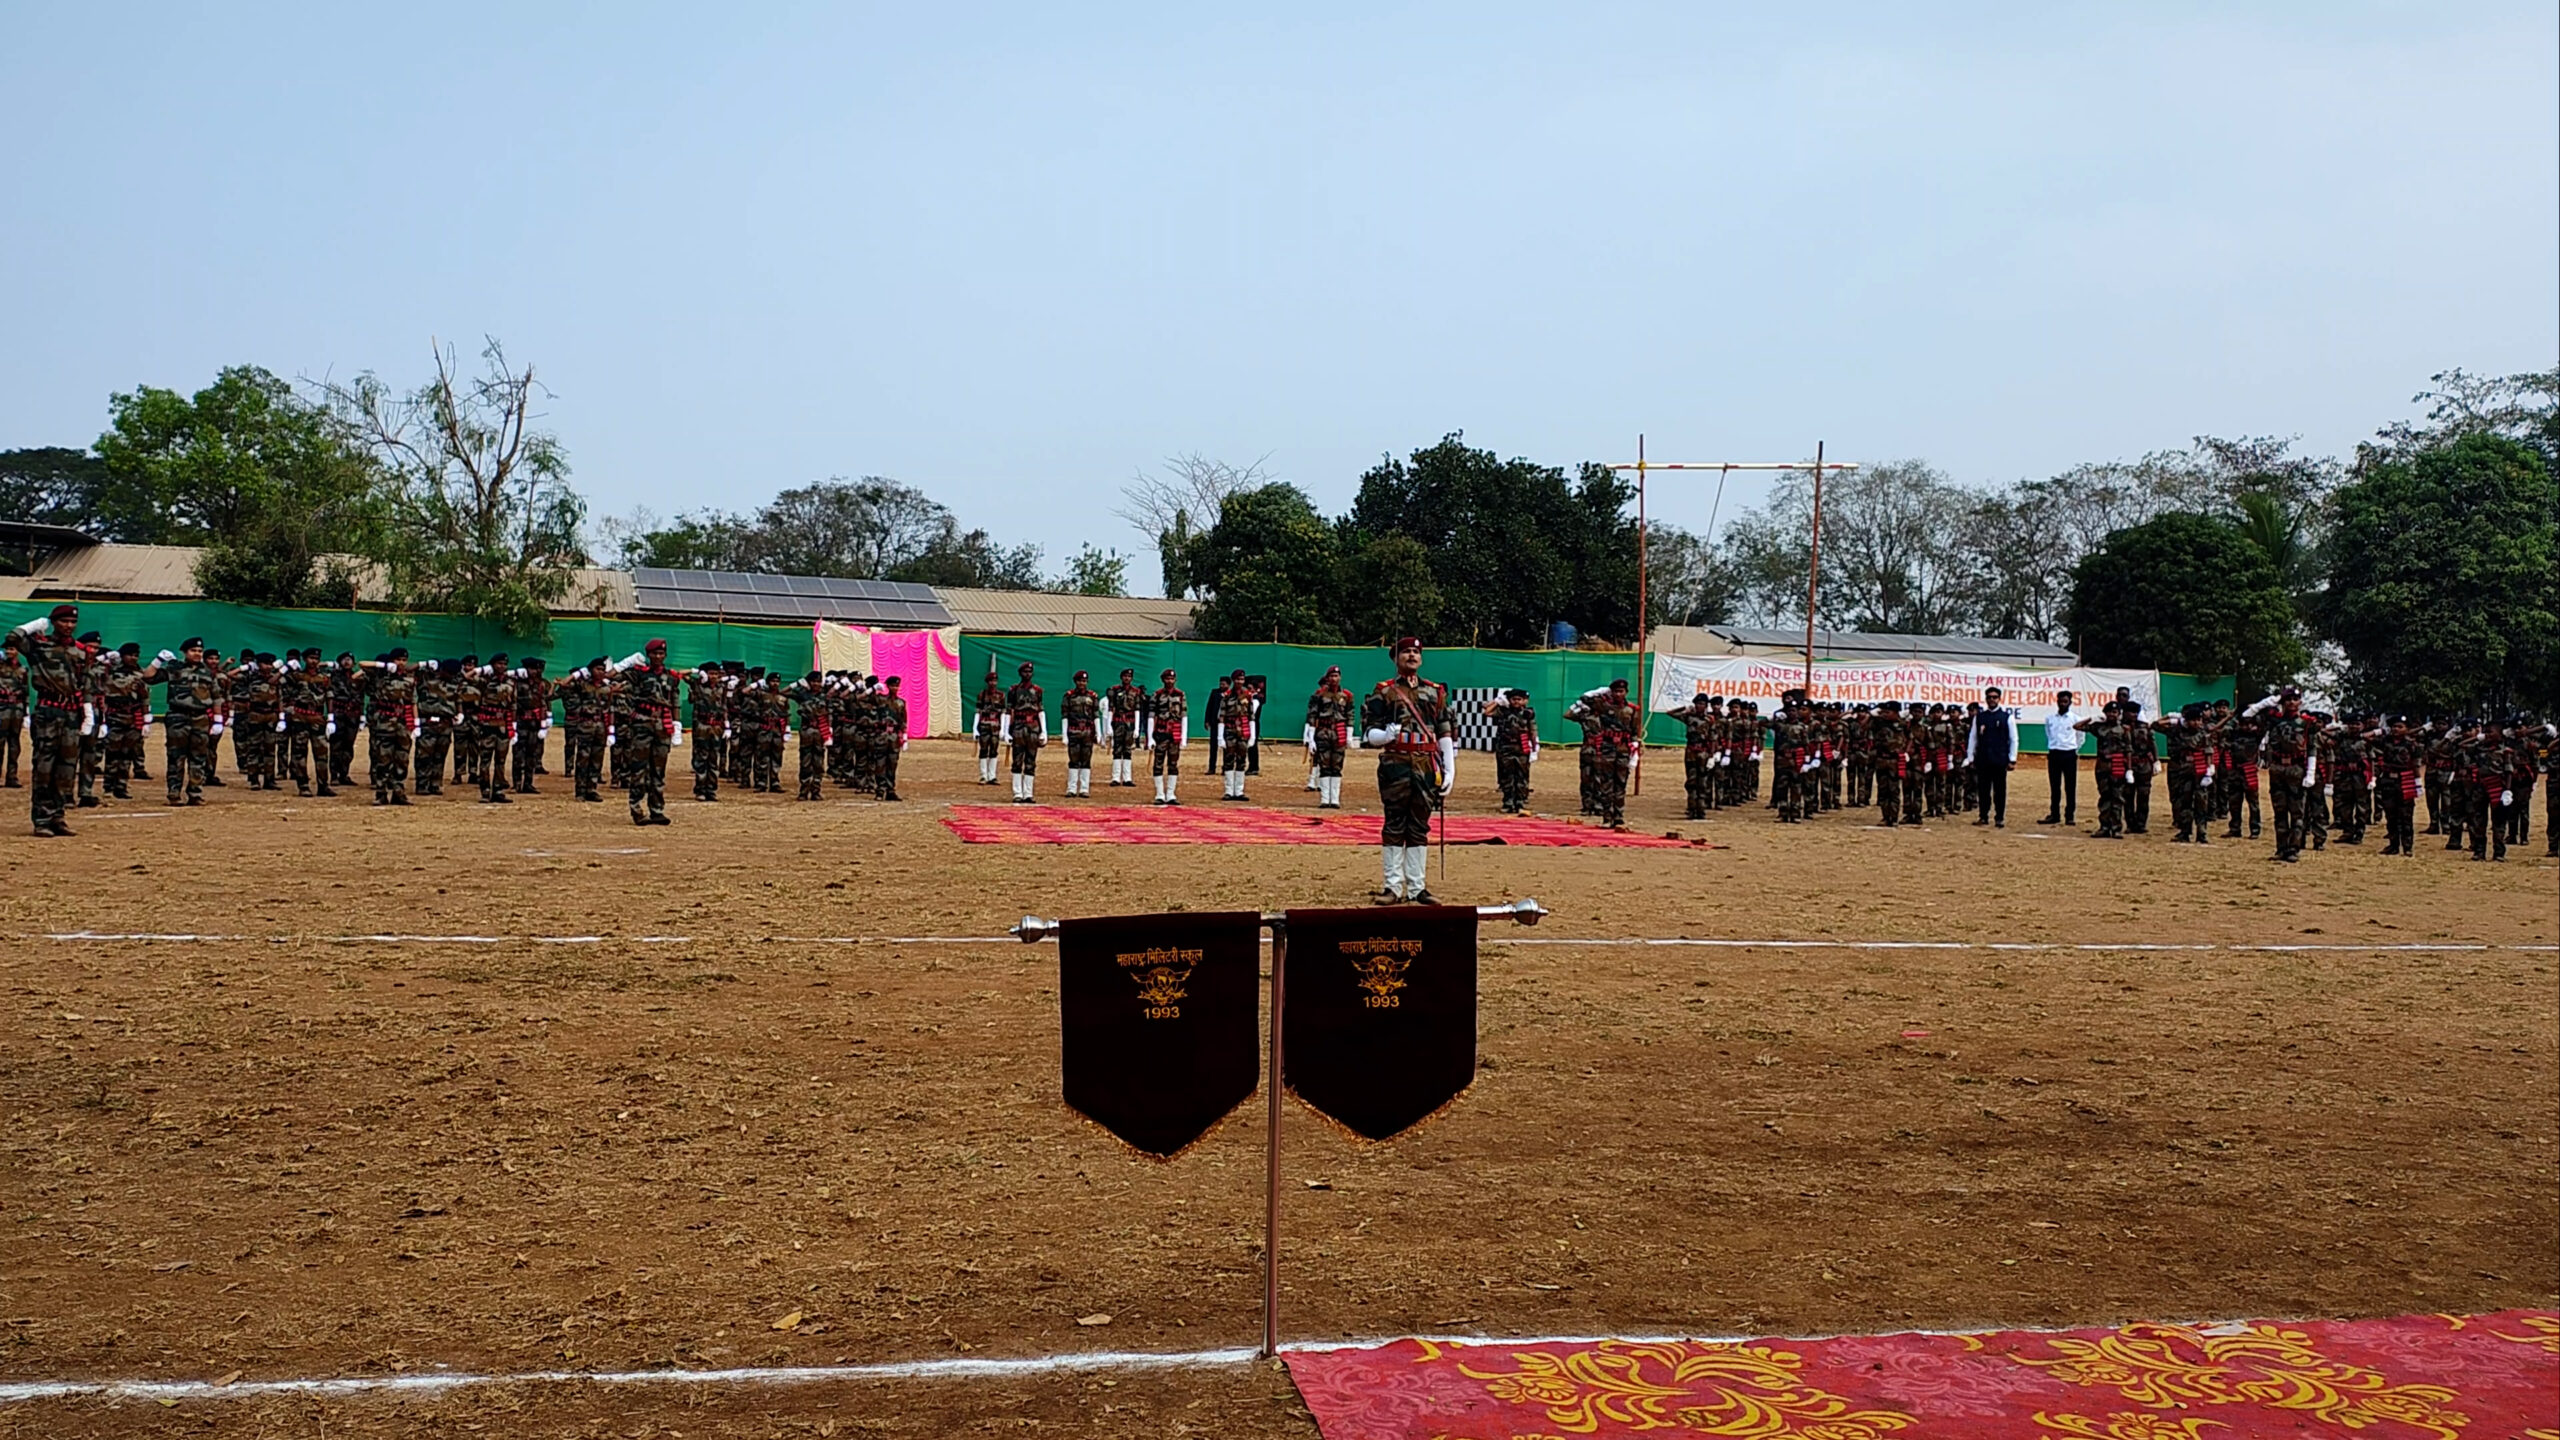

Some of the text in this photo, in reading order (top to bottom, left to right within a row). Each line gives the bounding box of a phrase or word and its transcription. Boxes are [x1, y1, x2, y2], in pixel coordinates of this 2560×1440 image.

[1747, 666, 1802, 681] UNDER
[1827, 669, 1891, 682] HOCKEY
[1895, 670, 1971, 686] NATIONAL
[1976, 675, 2072, 689] PARTICIPANT
[1836, 683, 1915, 701] MILITARY
[1920, 685, 1985, 705] SCHOOL
[1997, 688, 2082, 707] ELCOMS
[1400, 940, 1423, 957] स्कूल
[1180, 949, 1203, 966] स्कूल
[1363, 995, 1400, 1008] 1993
[1143, 1006, 1180, 1019] 1993
